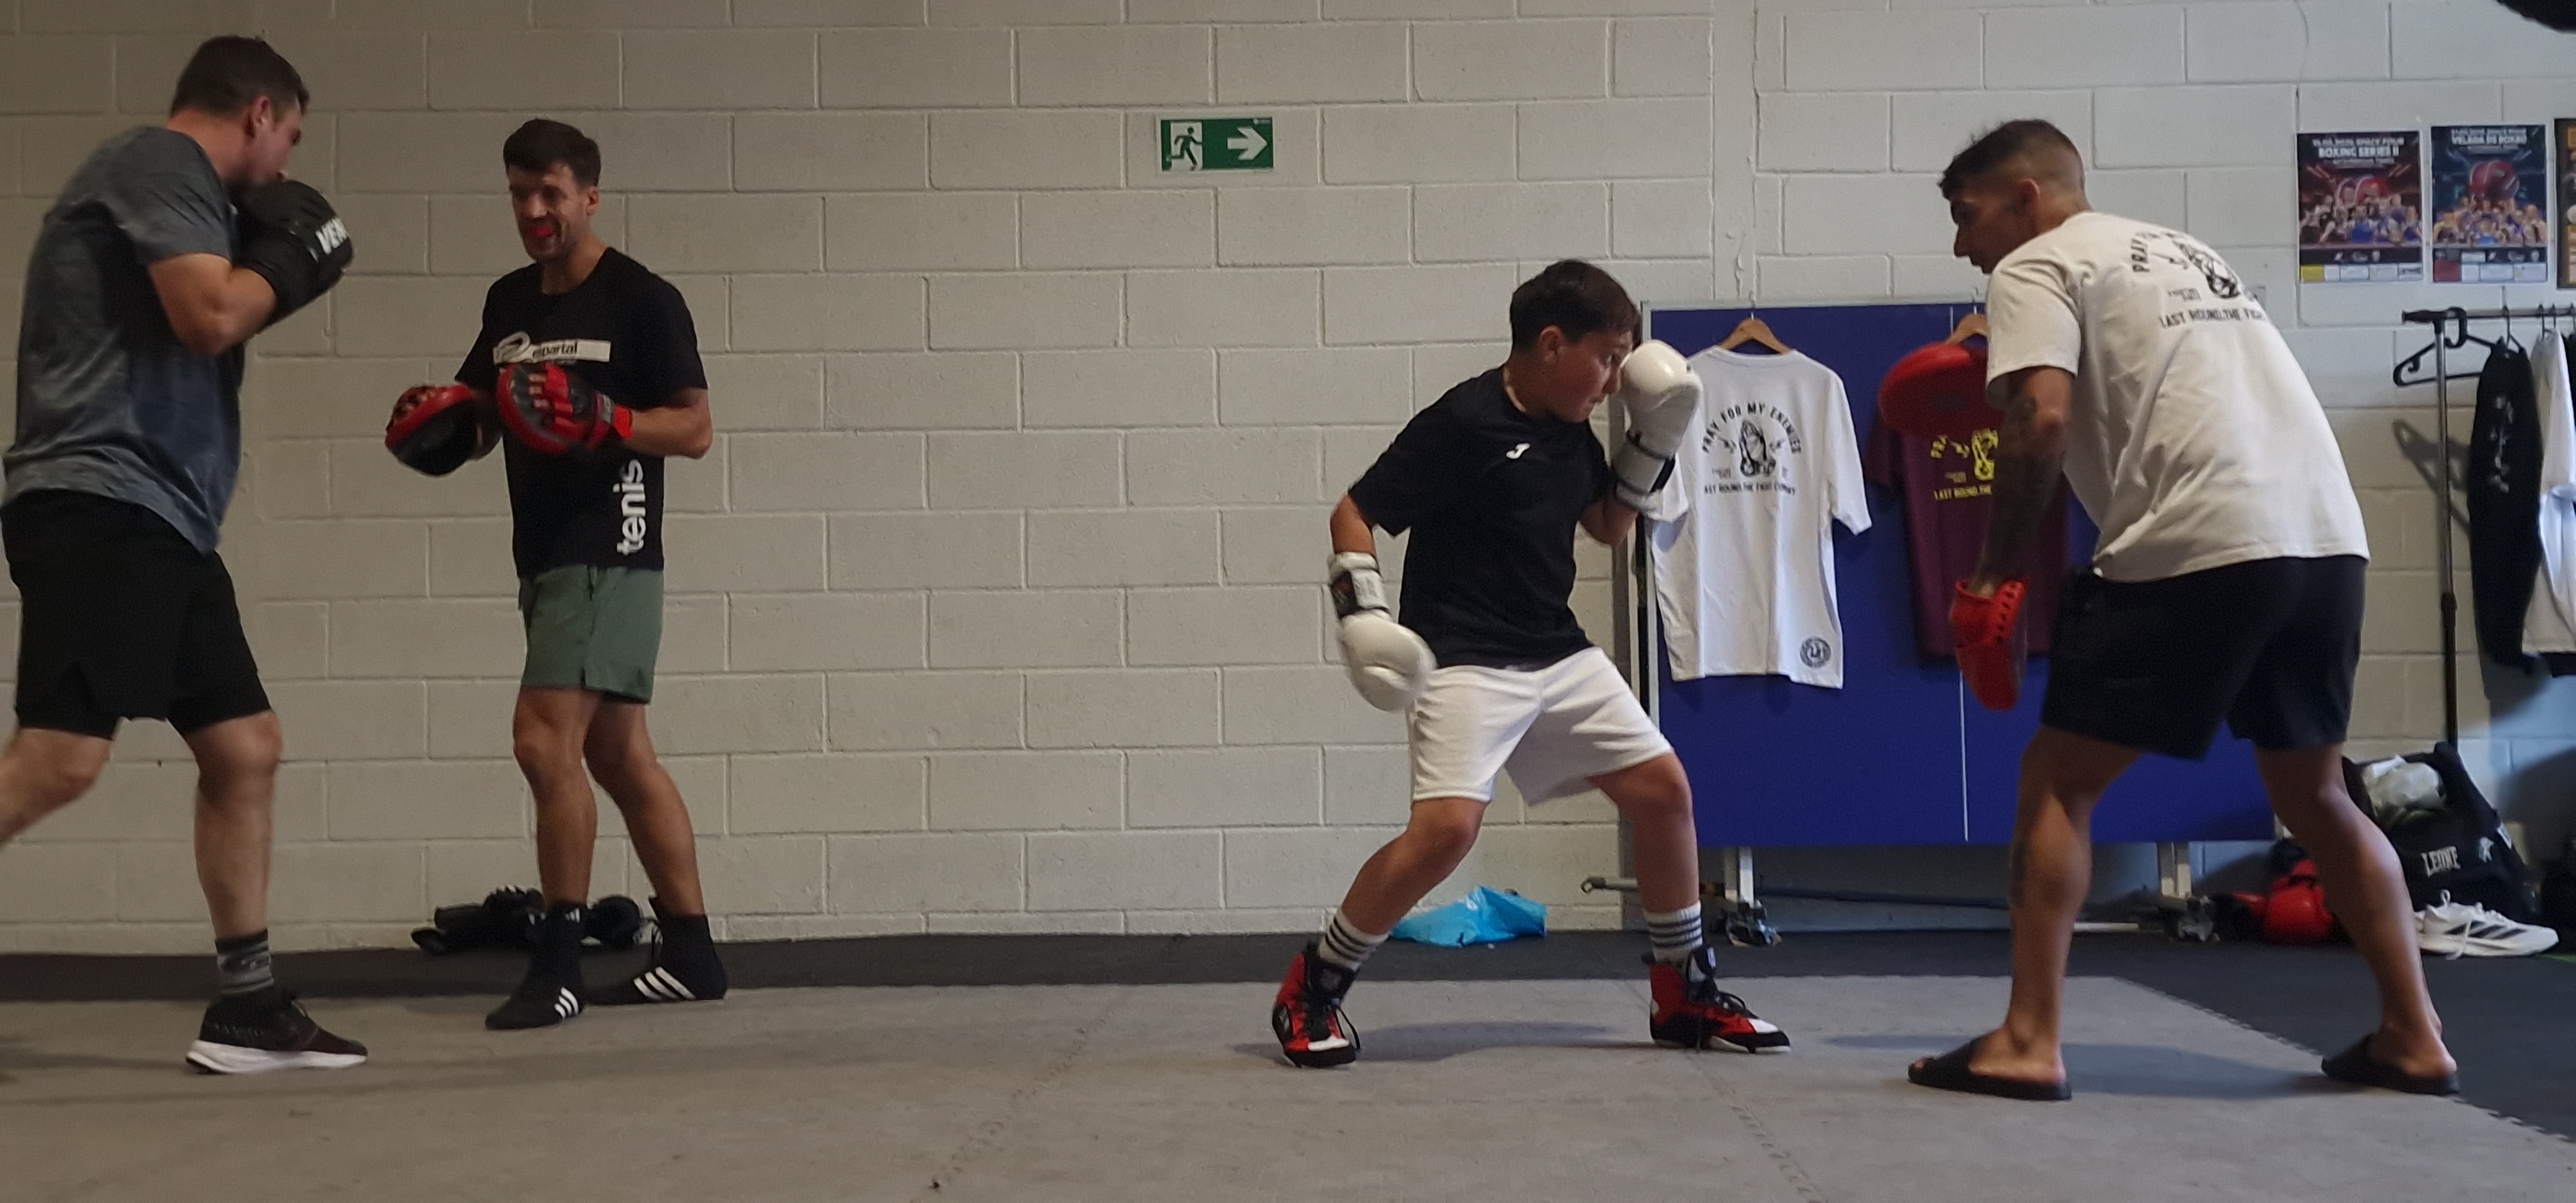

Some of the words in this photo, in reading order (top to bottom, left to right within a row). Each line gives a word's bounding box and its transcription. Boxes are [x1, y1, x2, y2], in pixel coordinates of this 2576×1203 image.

[2318, 147, 2357, 158] BOXING
[2159, 310, 2186, 329] LAST
[1702, 421, 1720, 453] PRAY
[1720, 405, 1741, 424] FOR
[1747, 402, 1765, 415] MY
[612, 459, 646, 556] tenis
[2421, 846, 2461, 878] LEONE
